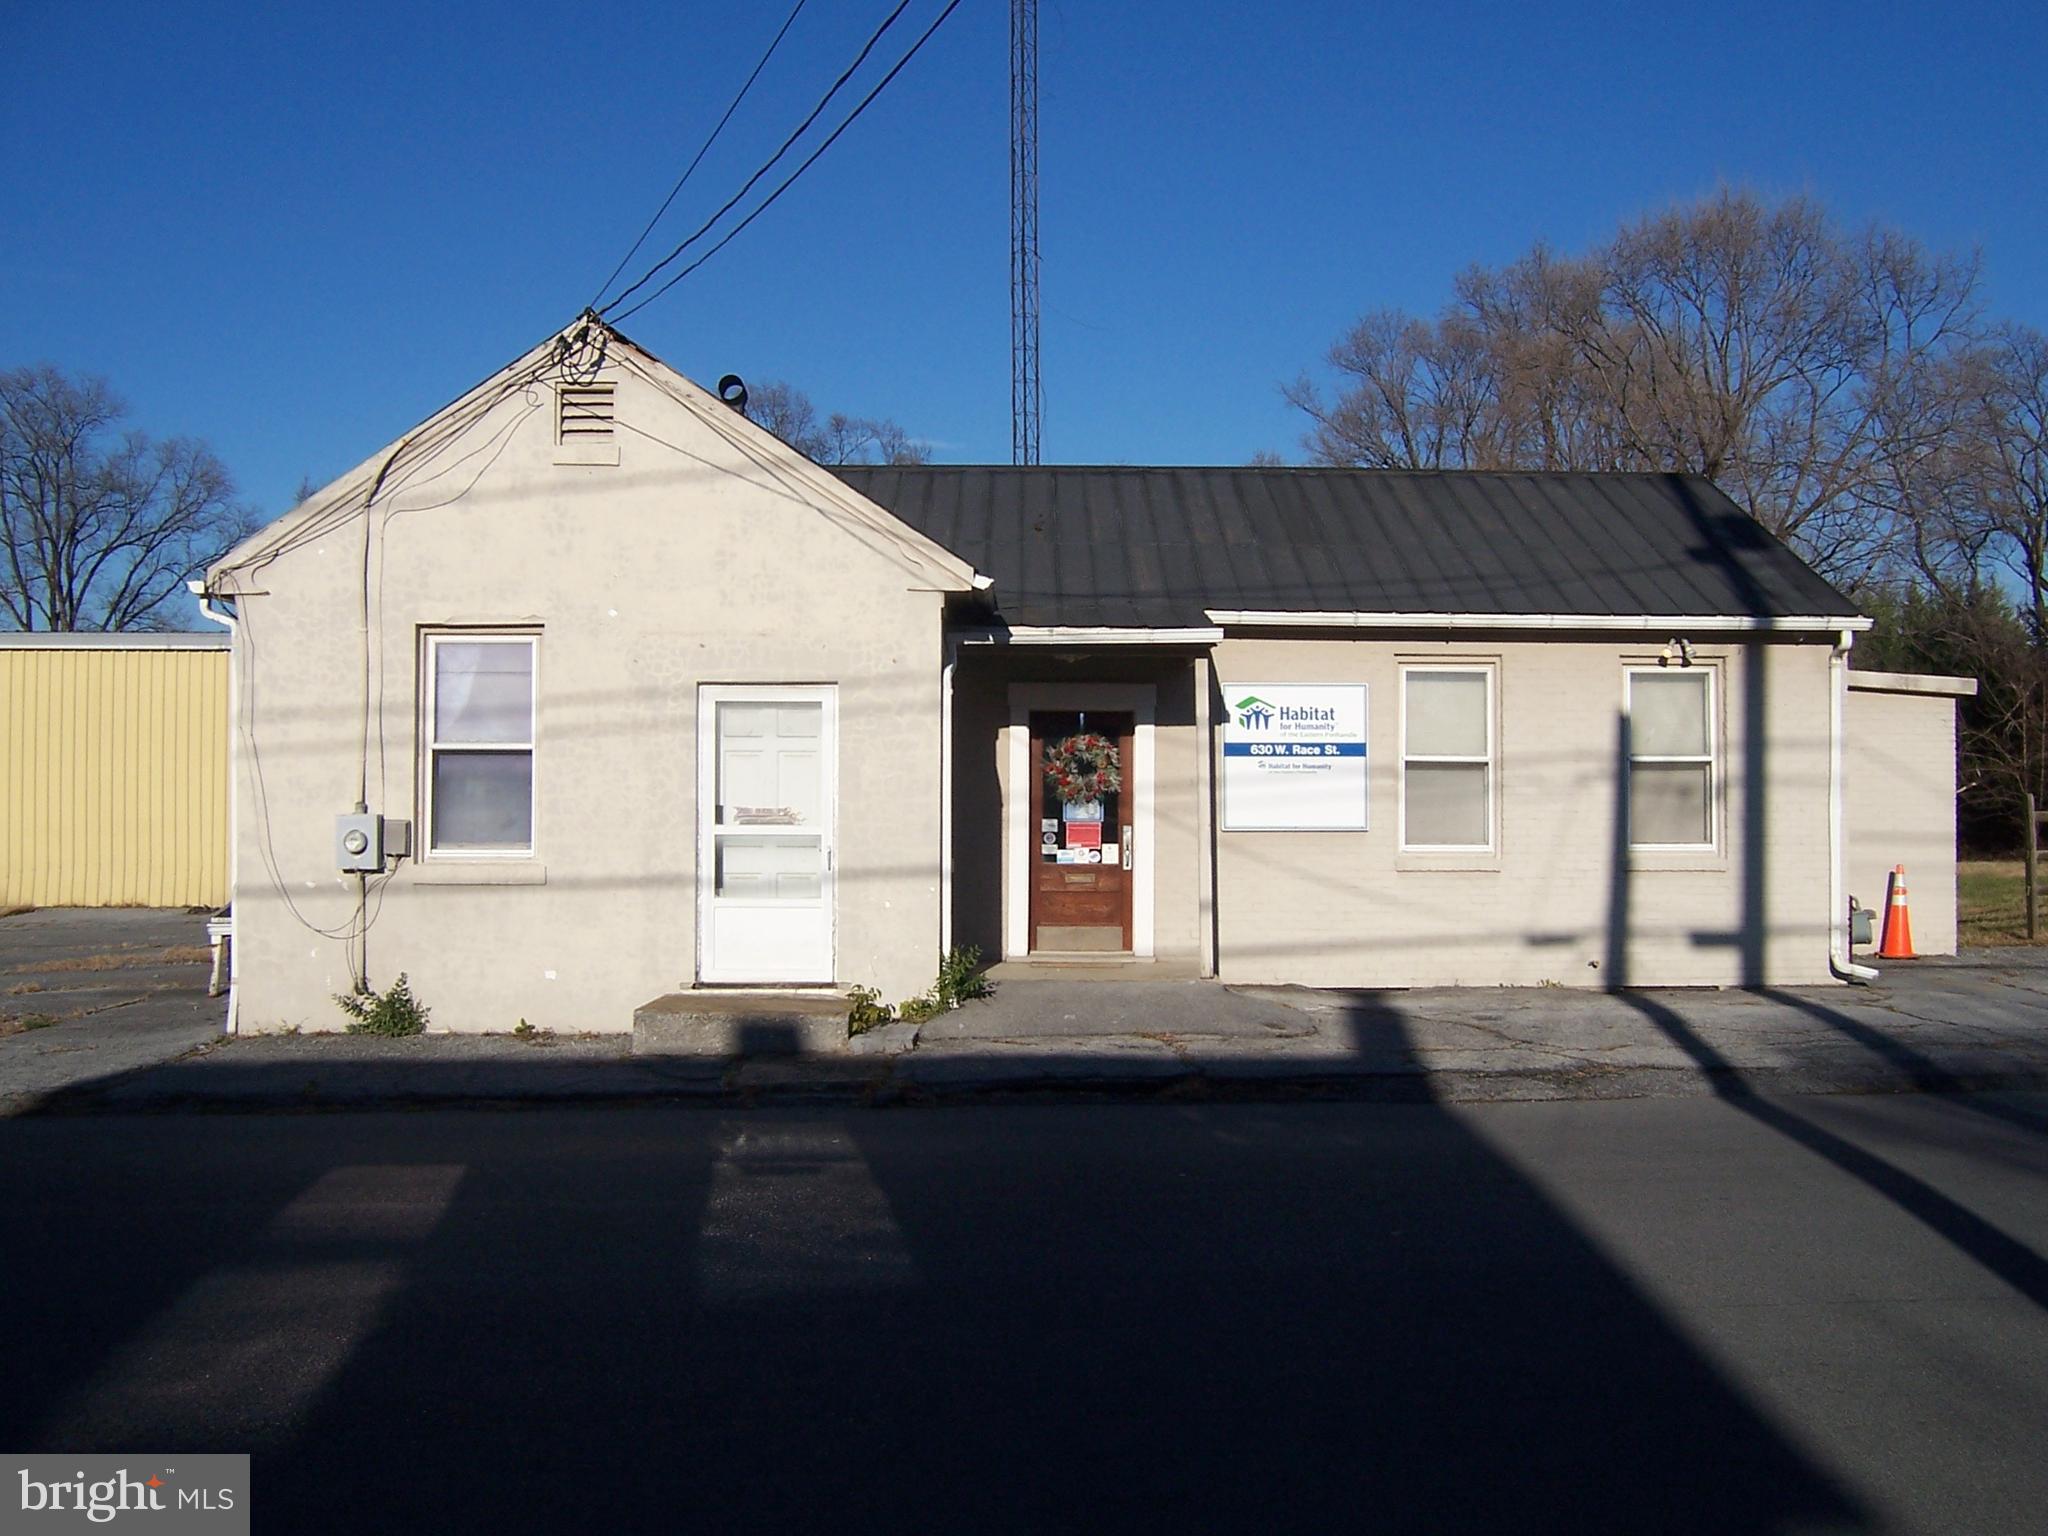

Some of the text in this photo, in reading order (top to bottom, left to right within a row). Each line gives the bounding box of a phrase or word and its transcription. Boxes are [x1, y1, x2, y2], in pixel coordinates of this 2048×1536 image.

[1279, 706, 1335, 721] Habitat
[1280, 722, 1335, 732] for Humanity
[1250, 744, 1341, 755] 630 W. Race St.
